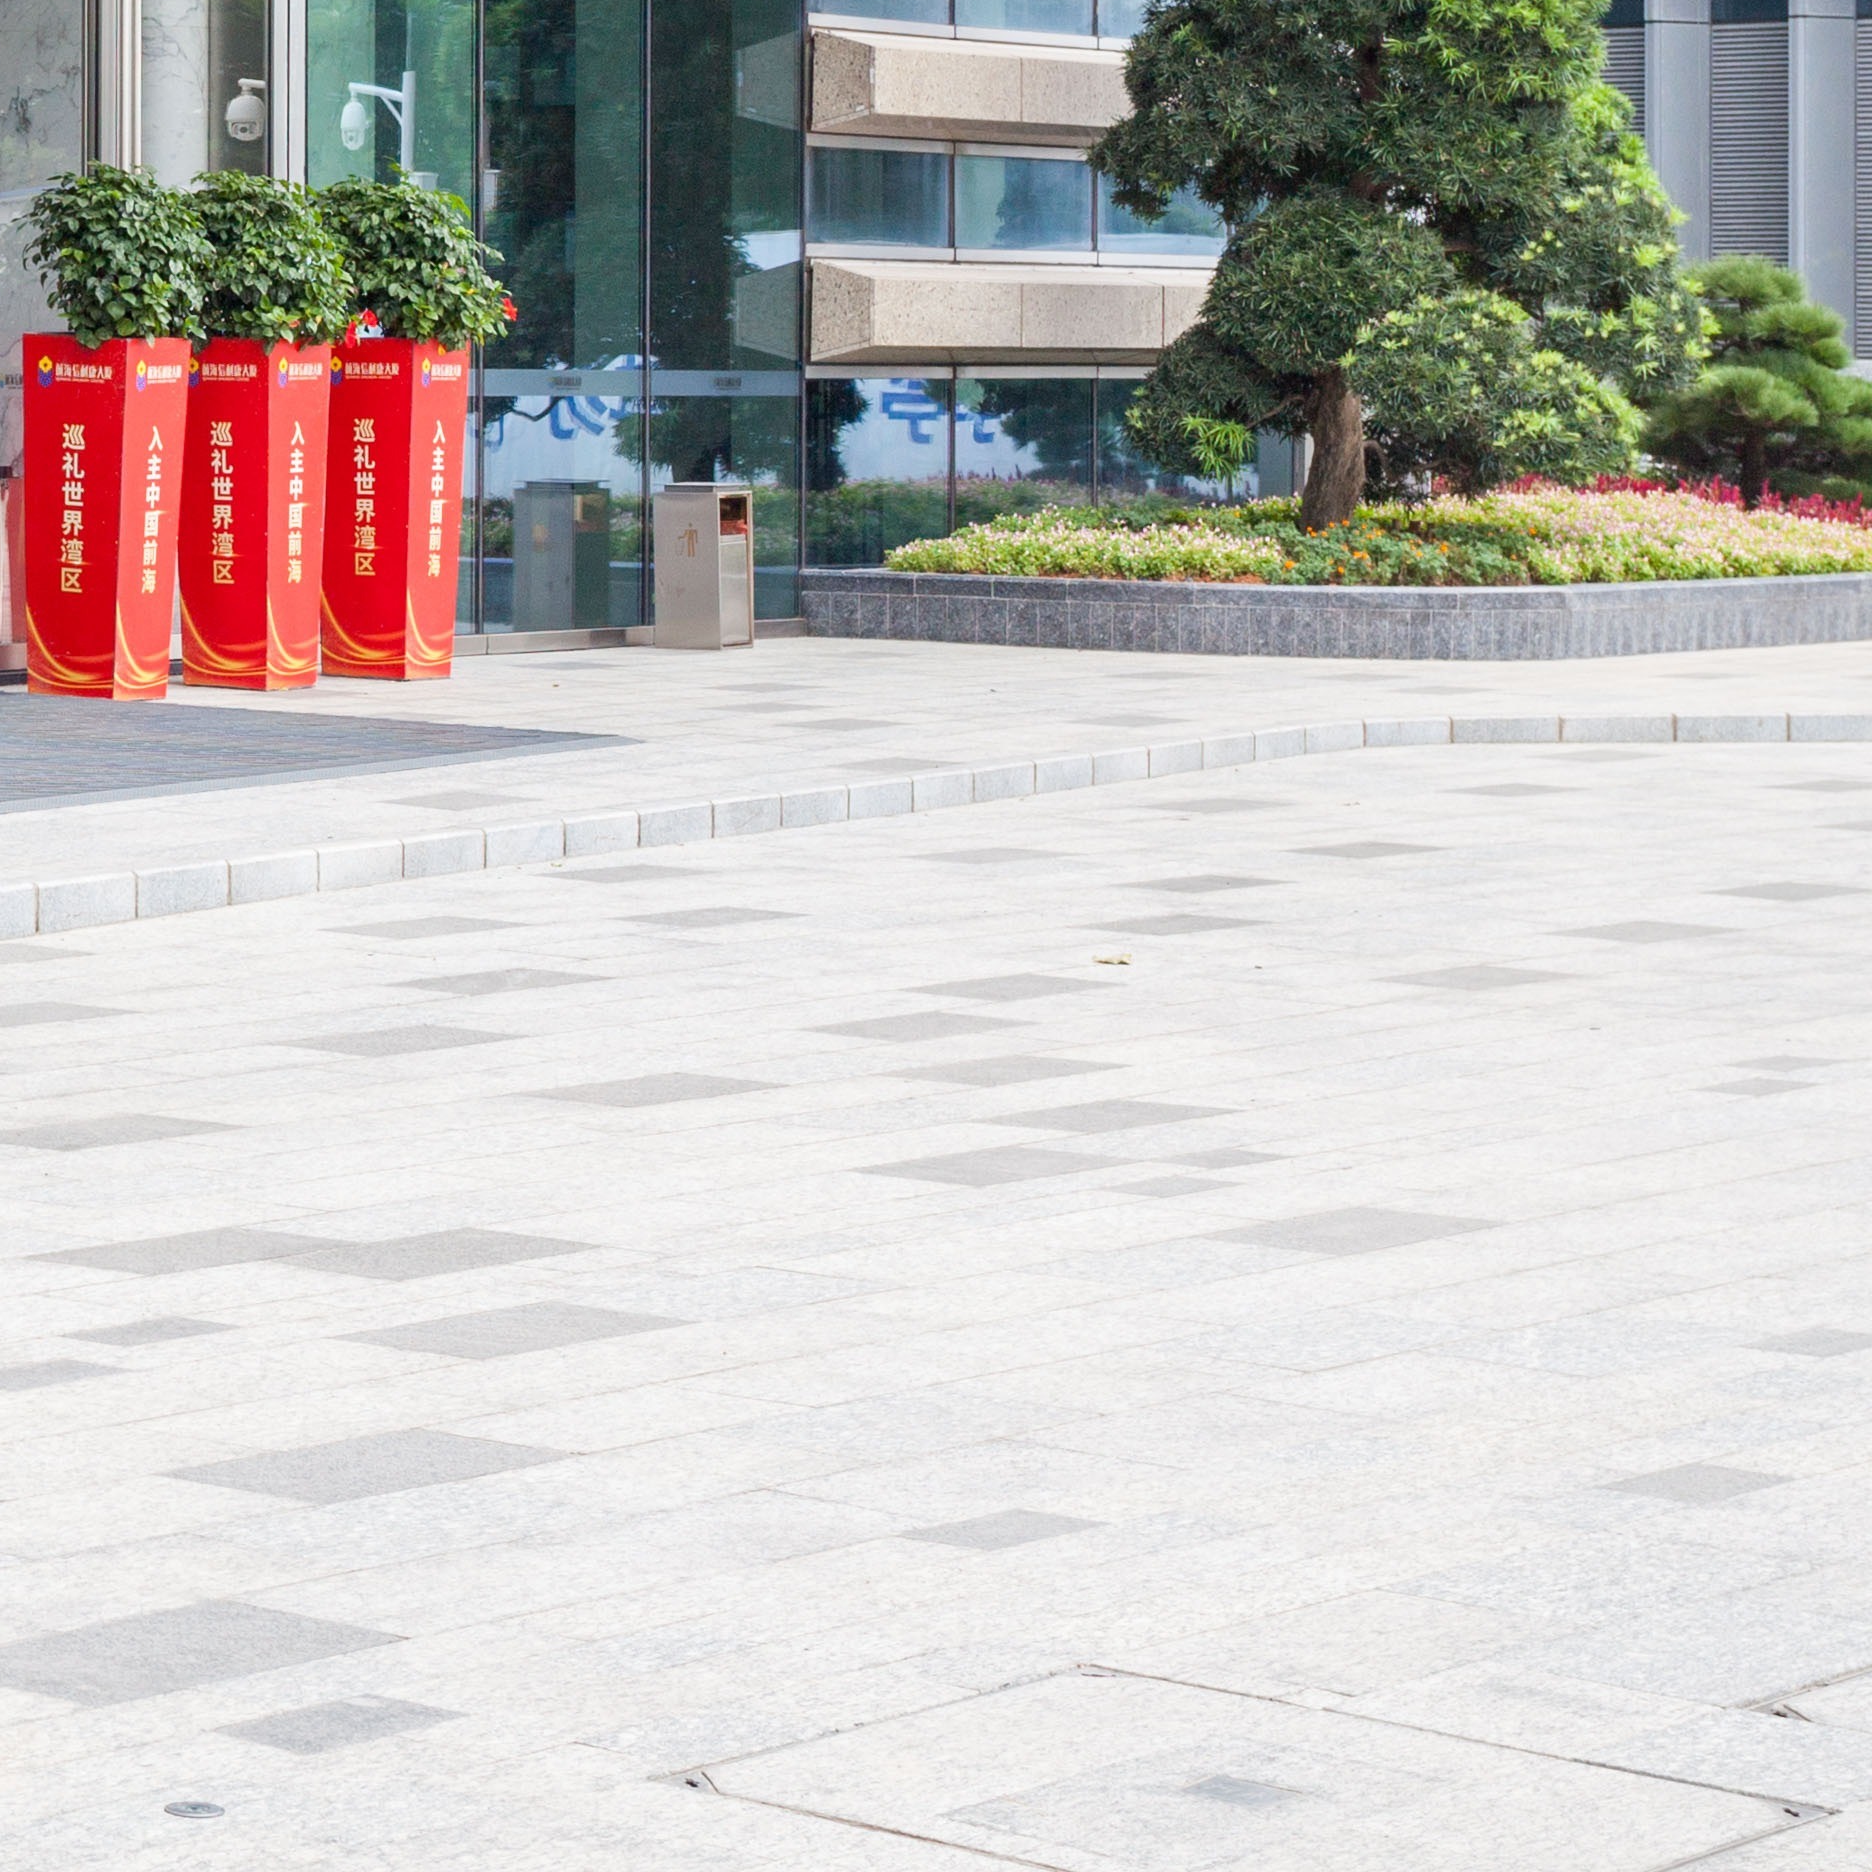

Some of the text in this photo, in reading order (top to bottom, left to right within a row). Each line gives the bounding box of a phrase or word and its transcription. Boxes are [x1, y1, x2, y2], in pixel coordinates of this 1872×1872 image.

[60, 423, 86, 594] 巡礼世界湾区
[141, 425, 164, 594] 入主中国前海
[210, 420, 236, 585] 巡礼世界湾区
[287, 421, 306, 583] 入主中国前海
[353, 418, 377, 577] 巡礼世界湾区
[427, 420, 447, 577] 入主中国前海
